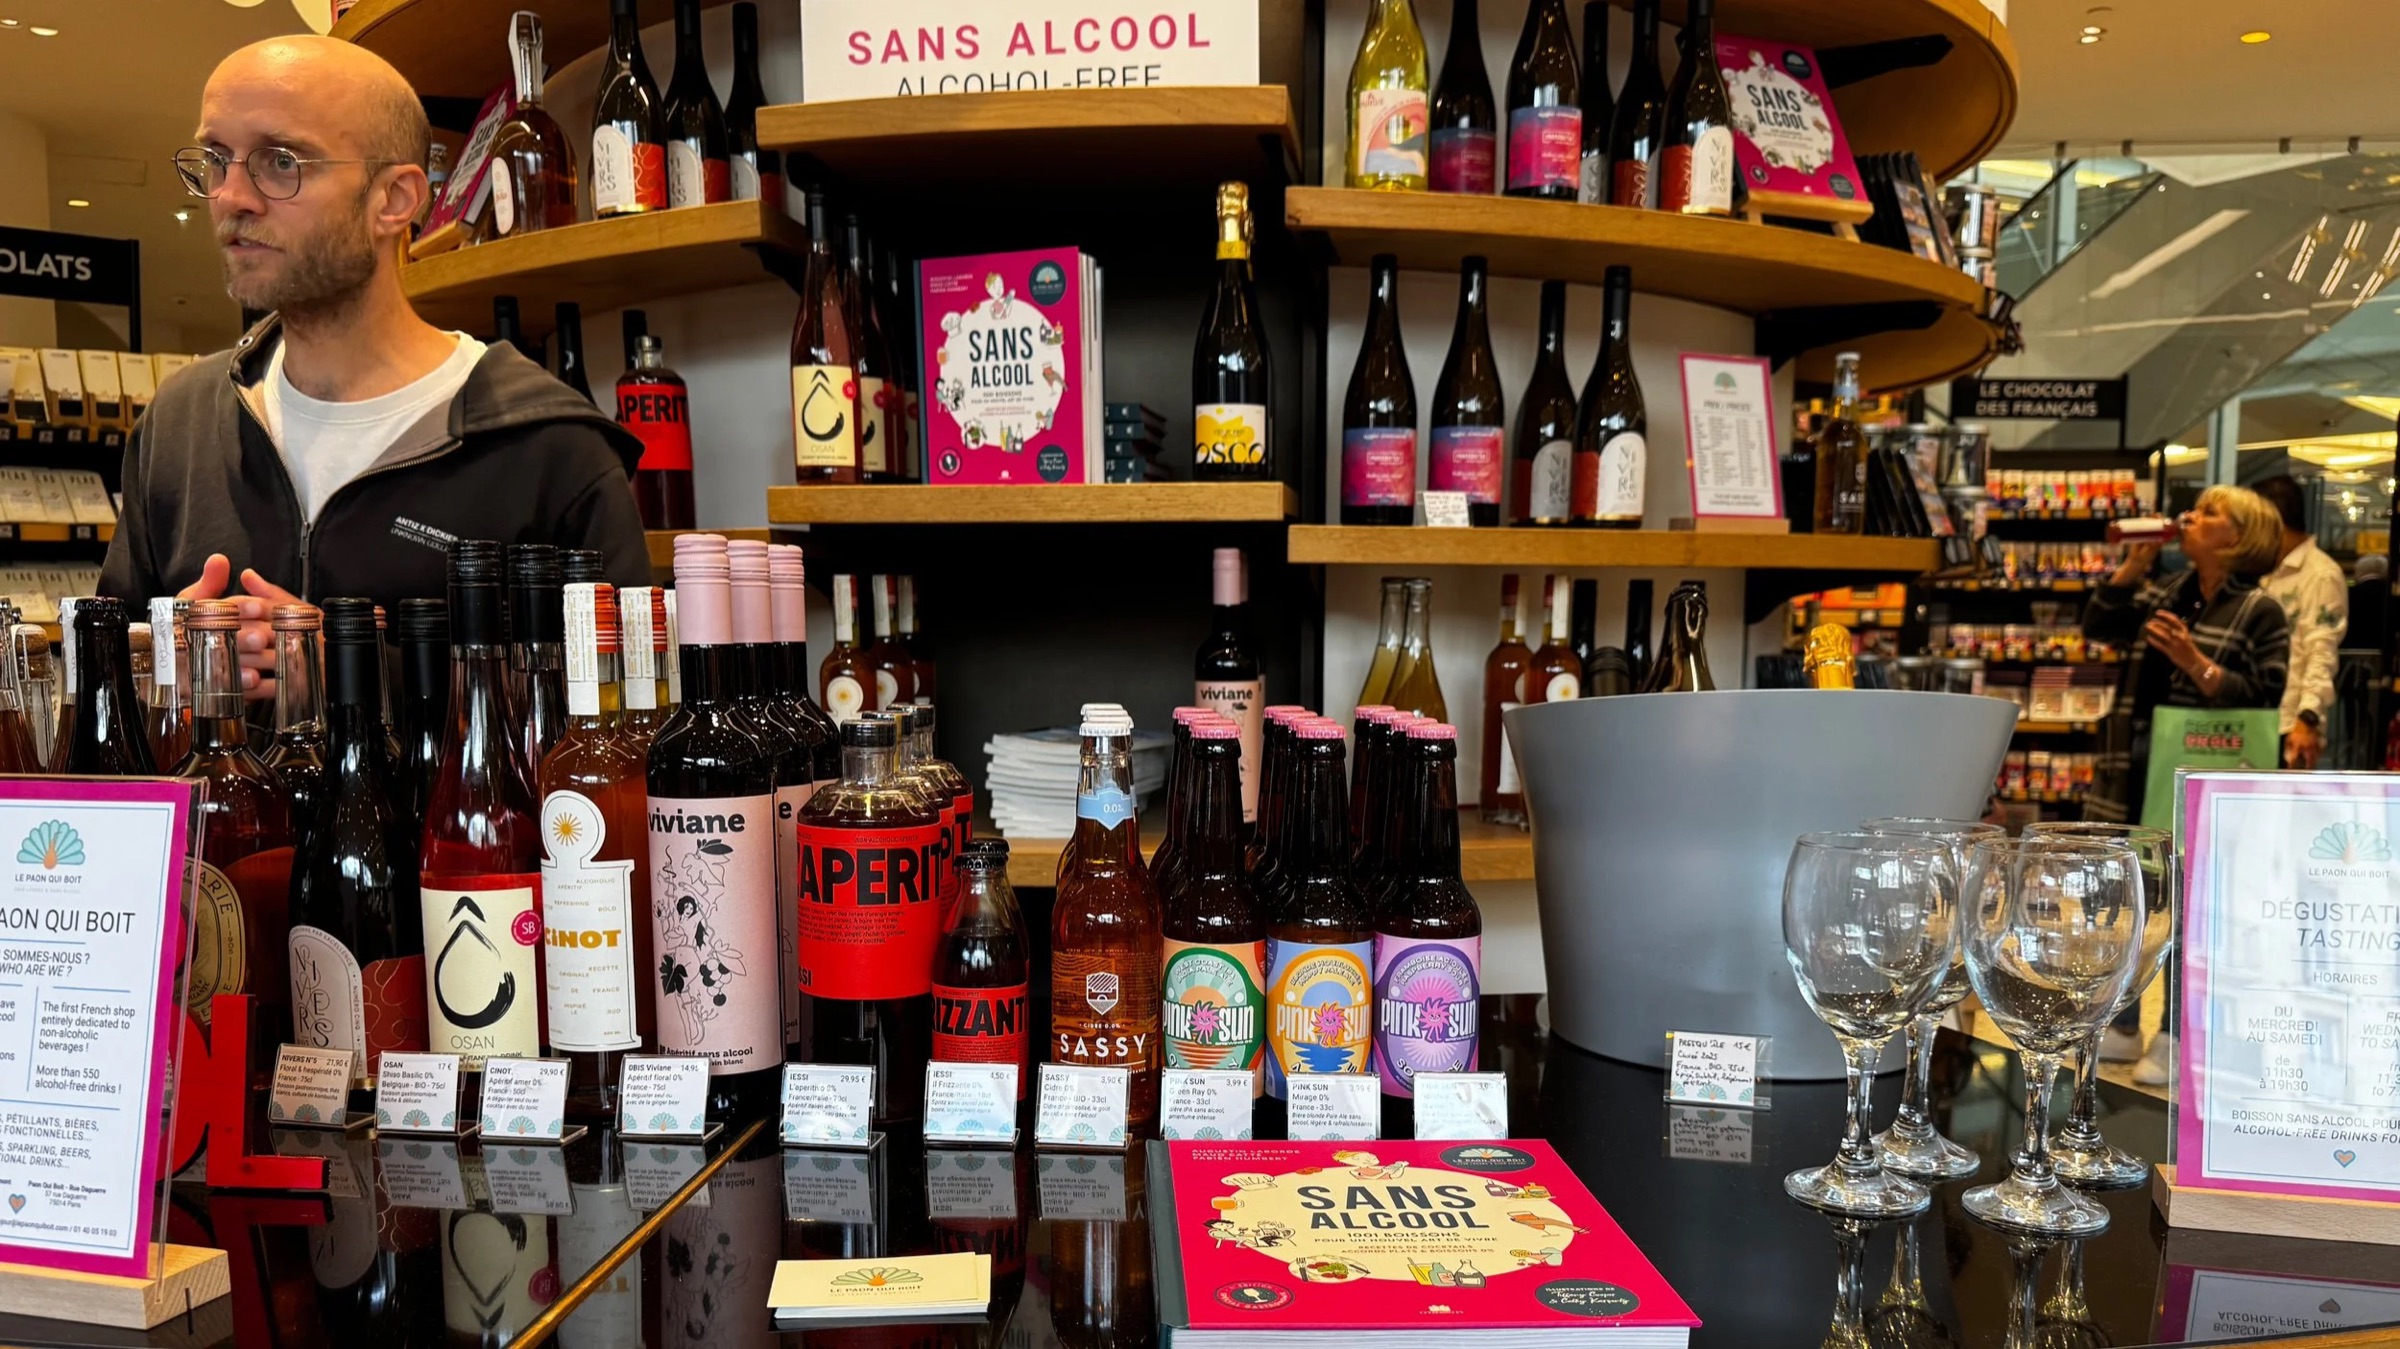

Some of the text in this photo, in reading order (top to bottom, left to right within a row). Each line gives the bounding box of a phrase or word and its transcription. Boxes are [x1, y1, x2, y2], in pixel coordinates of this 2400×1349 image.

[847, 12, 1211, 66] SANS ALCOOL
[1747, 84, 1802, 113] SANS
[968, 326, 1034, 362] SANS
[970, 363, 1034, 389] ALCOOL
[1979, 381, 2096, 399] LE CHOCOLAT
[1975, 401, 2099, 420] DES FRANÇAIS
[1200, 686, 1254, 702] viviane
[648, 808, 746, 834] viviane
[15, 874, 82, 884] LE PAON QUI BOIT
[2308, 868, 2320, 876] LE
[2321, 868, 2347, 877] PAON
[2368, 870, 2390, 878] BOIT
[45, 909, 80, 933] QUI
[86, 910, 136, 933] BOIT
[3, 949, 91, 964] SOMMES-NOUS ?
[24, 963, 72, 977] ARE WE ?
[2313, 971, 2378, 985] HORAIRES
[592, 986, 621, 994] FRANCE
[43, 1001, 135, 1018] The first French shop
[2274, 1005, 2293, 1017] DU
[41, 1015, 130, 1029] entirely dedicated to
[2248, 1018, 2318, 1031] MERCREDI
[40, 1028, 99, 1040] non-alcoholic
[2246, 1031, 2322, 1045] AU SAMEDI
[38, 1040, 84, 1053] beverages
[450, 1035, 495, 1050] OSAN
[1059, 1032, 1147, 1058] SASSY
[282, 1054, 305, 1063] NIVERS
[722, 1046, 754, 1058] alcool
[723, 1058, 744, 1066] blanc
[2274, 1055, 2291, 1066] de
[36, 1065, 100, 1079] More than 550
[280, 1064, 297, 1072] Floral
[383, 1071, 401, 1079] Shiso
[402, 1071, 423, 1079] Basilic
[490, 1067, 559, 1076] CINOT 29,90
[646, 1064, 672, 1072] Viviane
[2265, 1067, 2304, 1079] 11h30
[278, 1073, 297, 1081] France
[840, 1075, 860, 1083] 29,95
[1044, 1073, 1117, 1084] SASSY 3,90
[35, 1079, 87, 1091] alcohol-free
[88, 1082, 116, 1094] drinks
[381, 1080, 410, 1090] Belgique
[1192, 1088, 1217, 1096] Ray 0%
[1292, 1083, 1329, 1091] PINK SUN
[2271, 1079, 2309, 1092] 19h30
[1292, 1093, 1317, 1102] Mirage
[6, 1113, 63, 1129] PÉTILLANTS,
[2232, 1110, 2284, 1122] BOISSON
[2286, 1113, 2319, 1125] SANS
[2321, 1115, 2370, 1128] ALCOOL
[2233, 1124, 2378, 1143] ALCOHOL-FREE DRINKS
[7, 1142, 92, 1160] SPARKLING, BEERS,
[1297, 1185, 1477, 1210] SANS
[1310, 1211, 1490, 1230] ALCOOL
